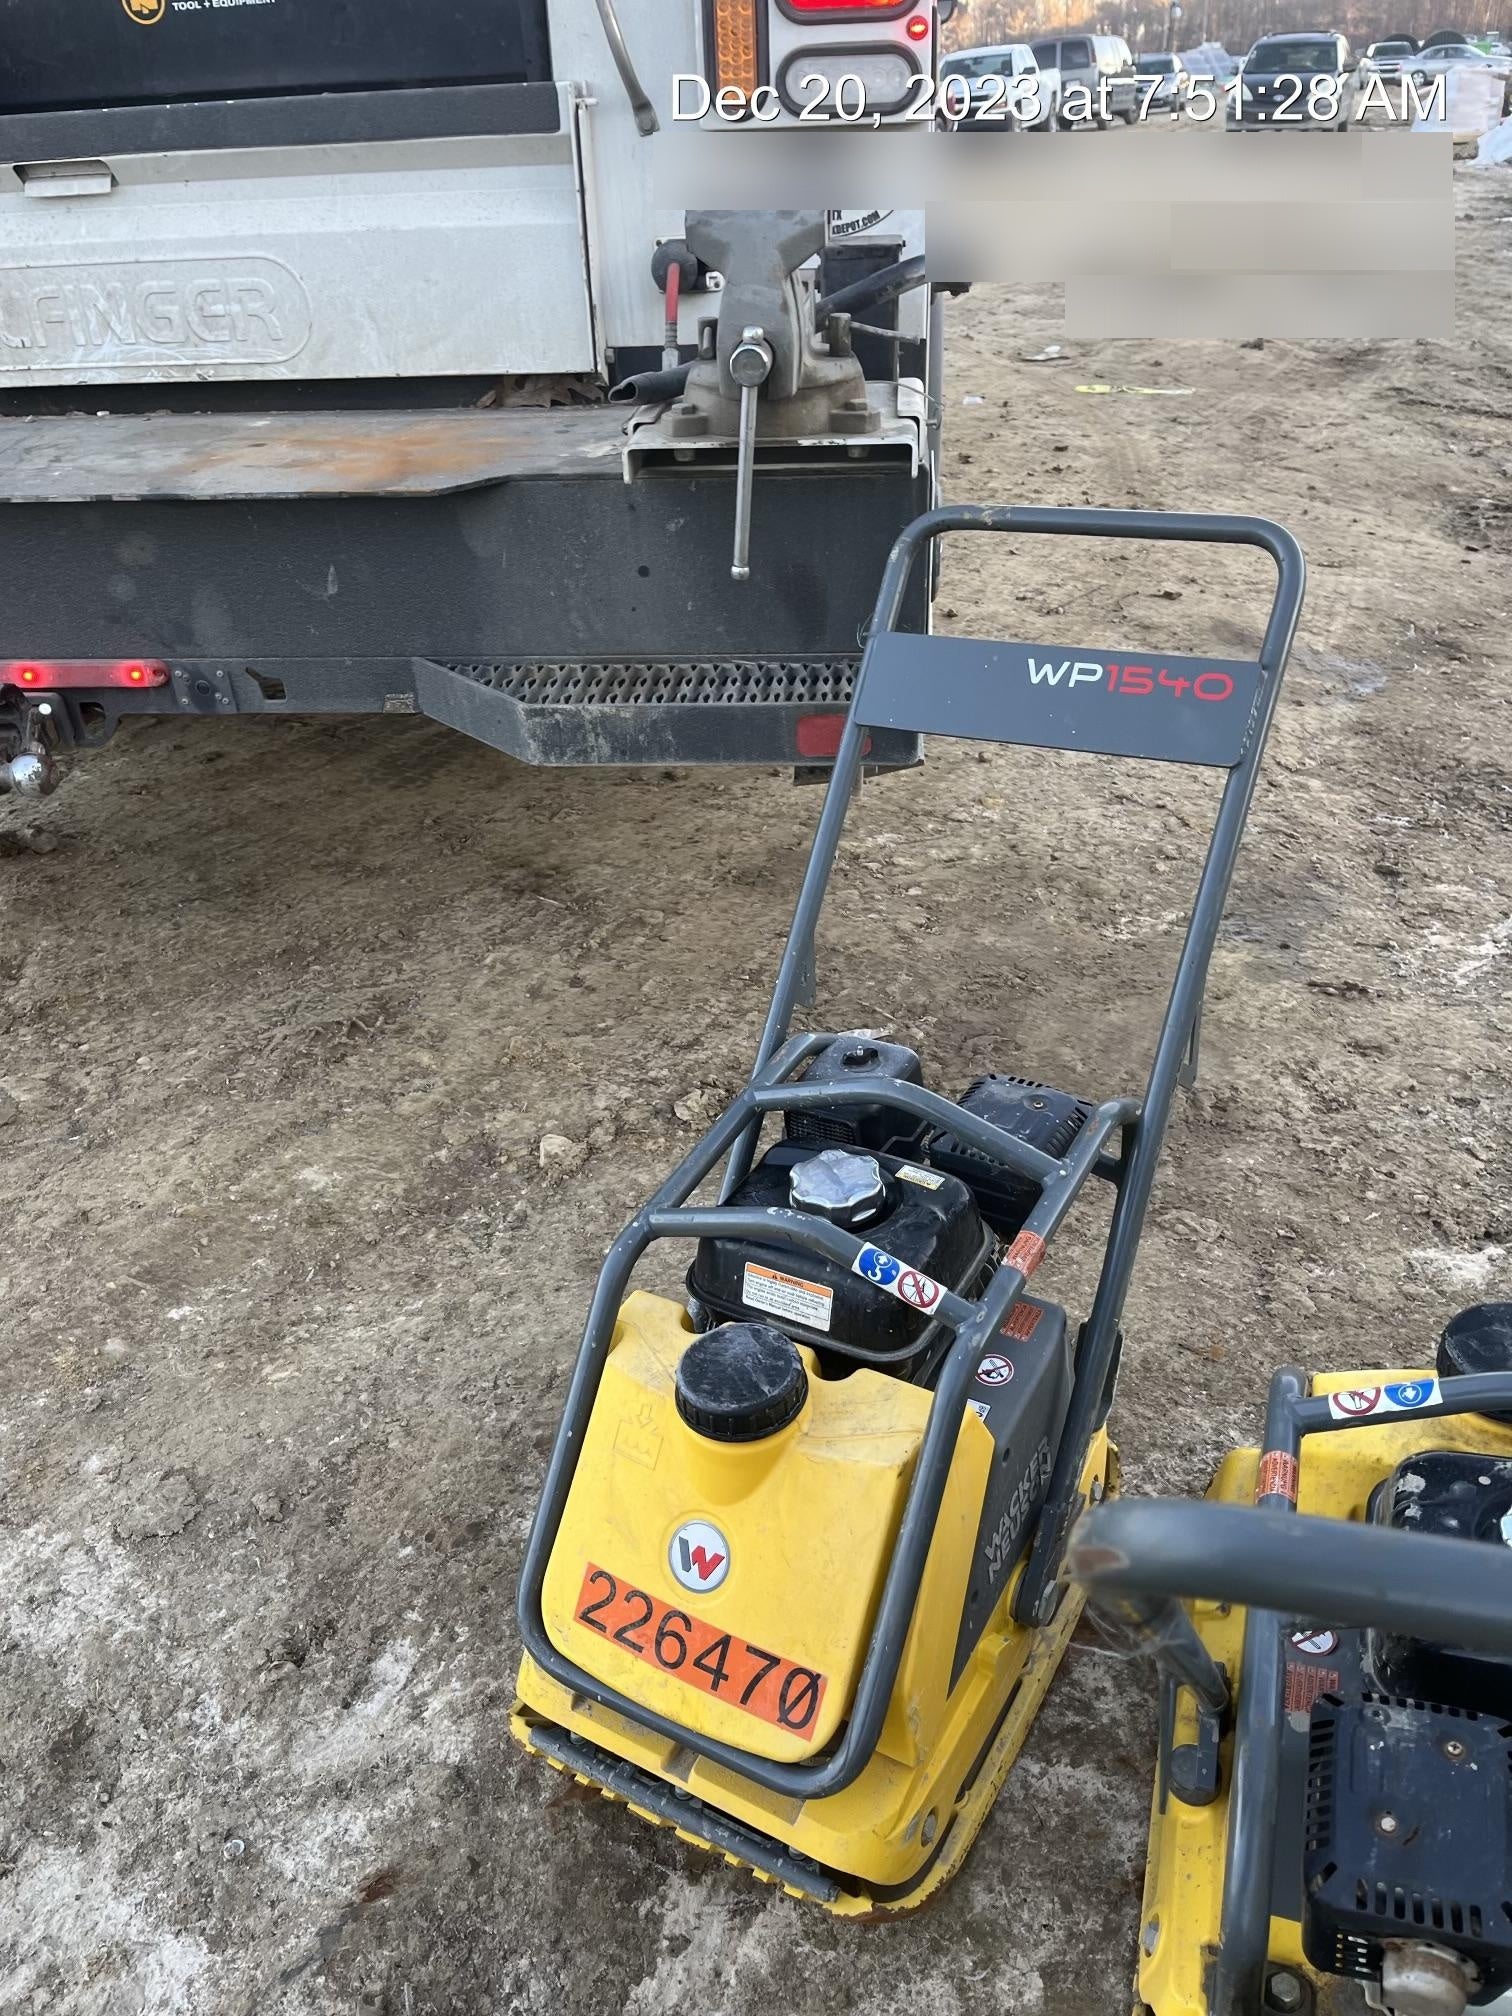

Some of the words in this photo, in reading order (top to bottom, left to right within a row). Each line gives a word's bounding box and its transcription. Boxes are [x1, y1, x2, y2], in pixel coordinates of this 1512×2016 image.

[172, 2, 201, 11] TOOL
[203, 0, 211, 8] +
[1027, 657, 1235, 703] WP1540
[779, 1275, 803, 1287] WARNING
[985, 1436, 1049, 1561] WACKER
[579, 1569, 820, 1730] 226470
